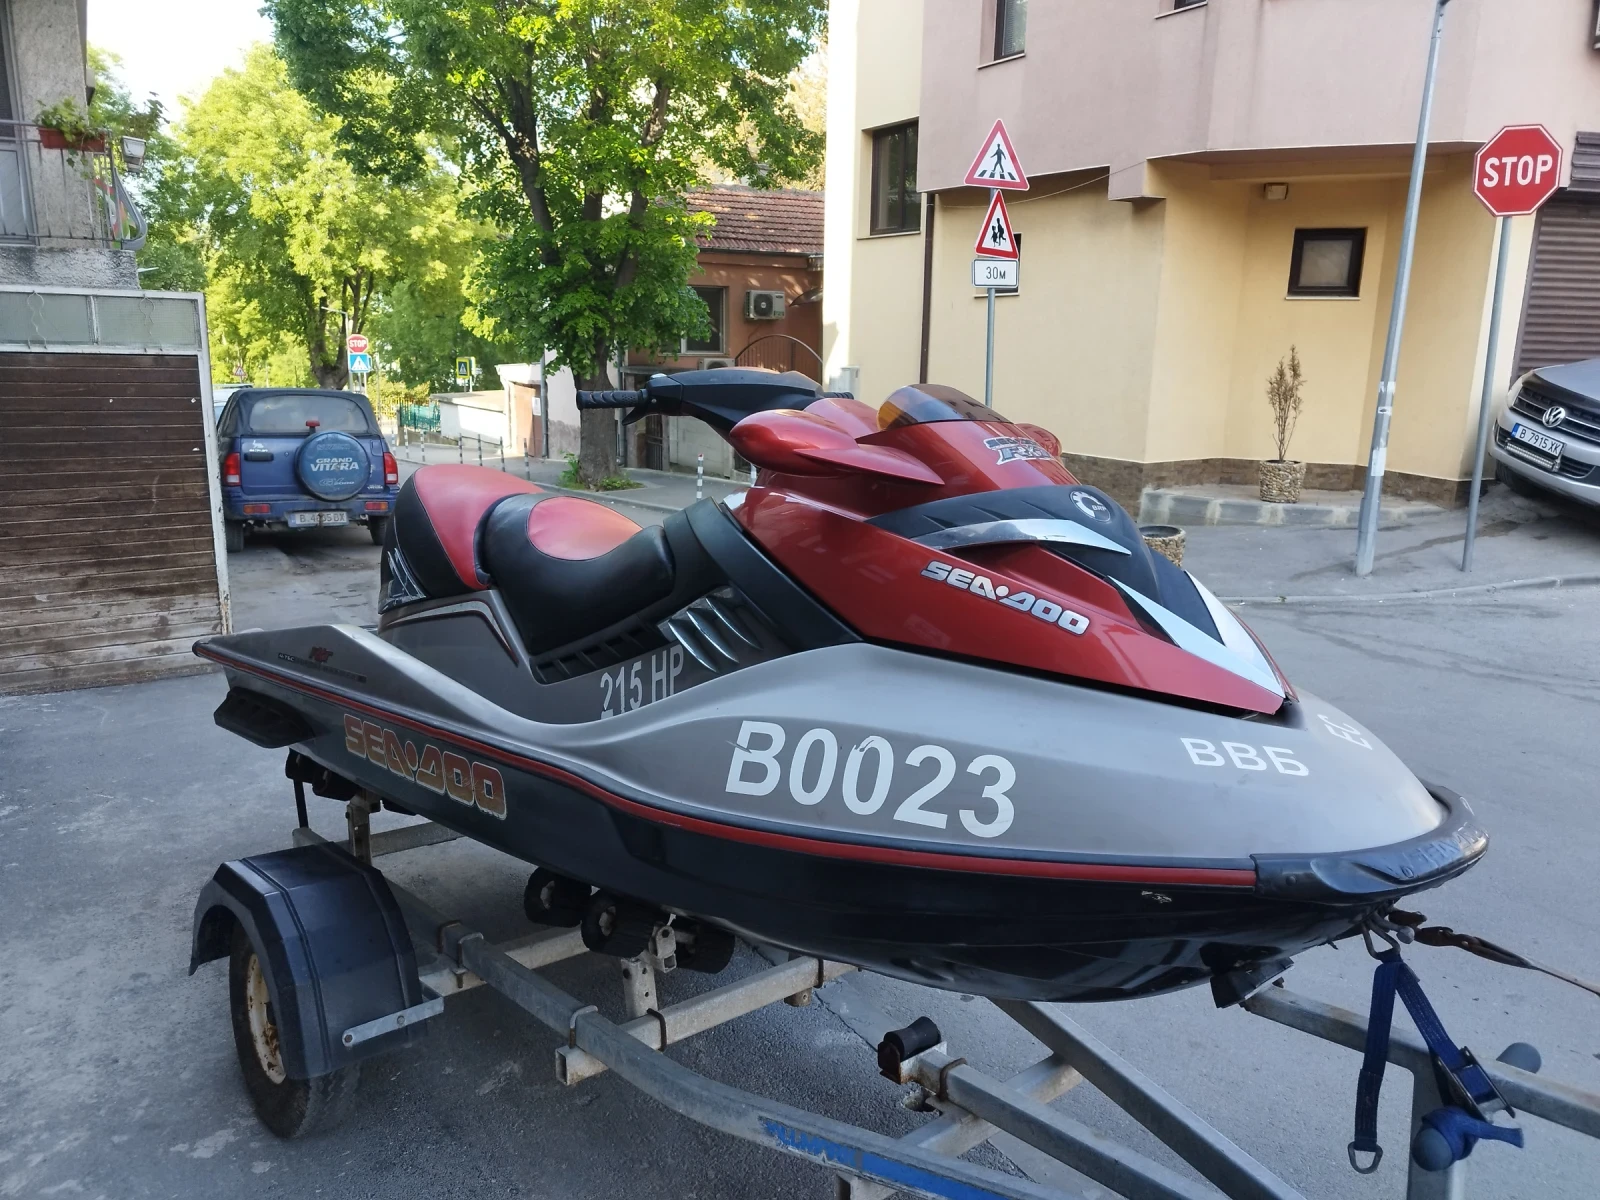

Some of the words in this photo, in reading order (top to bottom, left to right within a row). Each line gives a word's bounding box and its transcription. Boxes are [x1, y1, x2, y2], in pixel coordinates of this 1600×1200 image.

[1483, 154, 1553, 188] STOP
[350, 340, 367, 348] STOP
[1519, 428, 1527, 439] B
[1528, 432, 1549, 449] 7915
[310, 462, 360, 472] VITARA
[600, 660, 643, 720] 215
[651, 644, 684, 704] HP
[725, 720, 1017, 838] B0023
